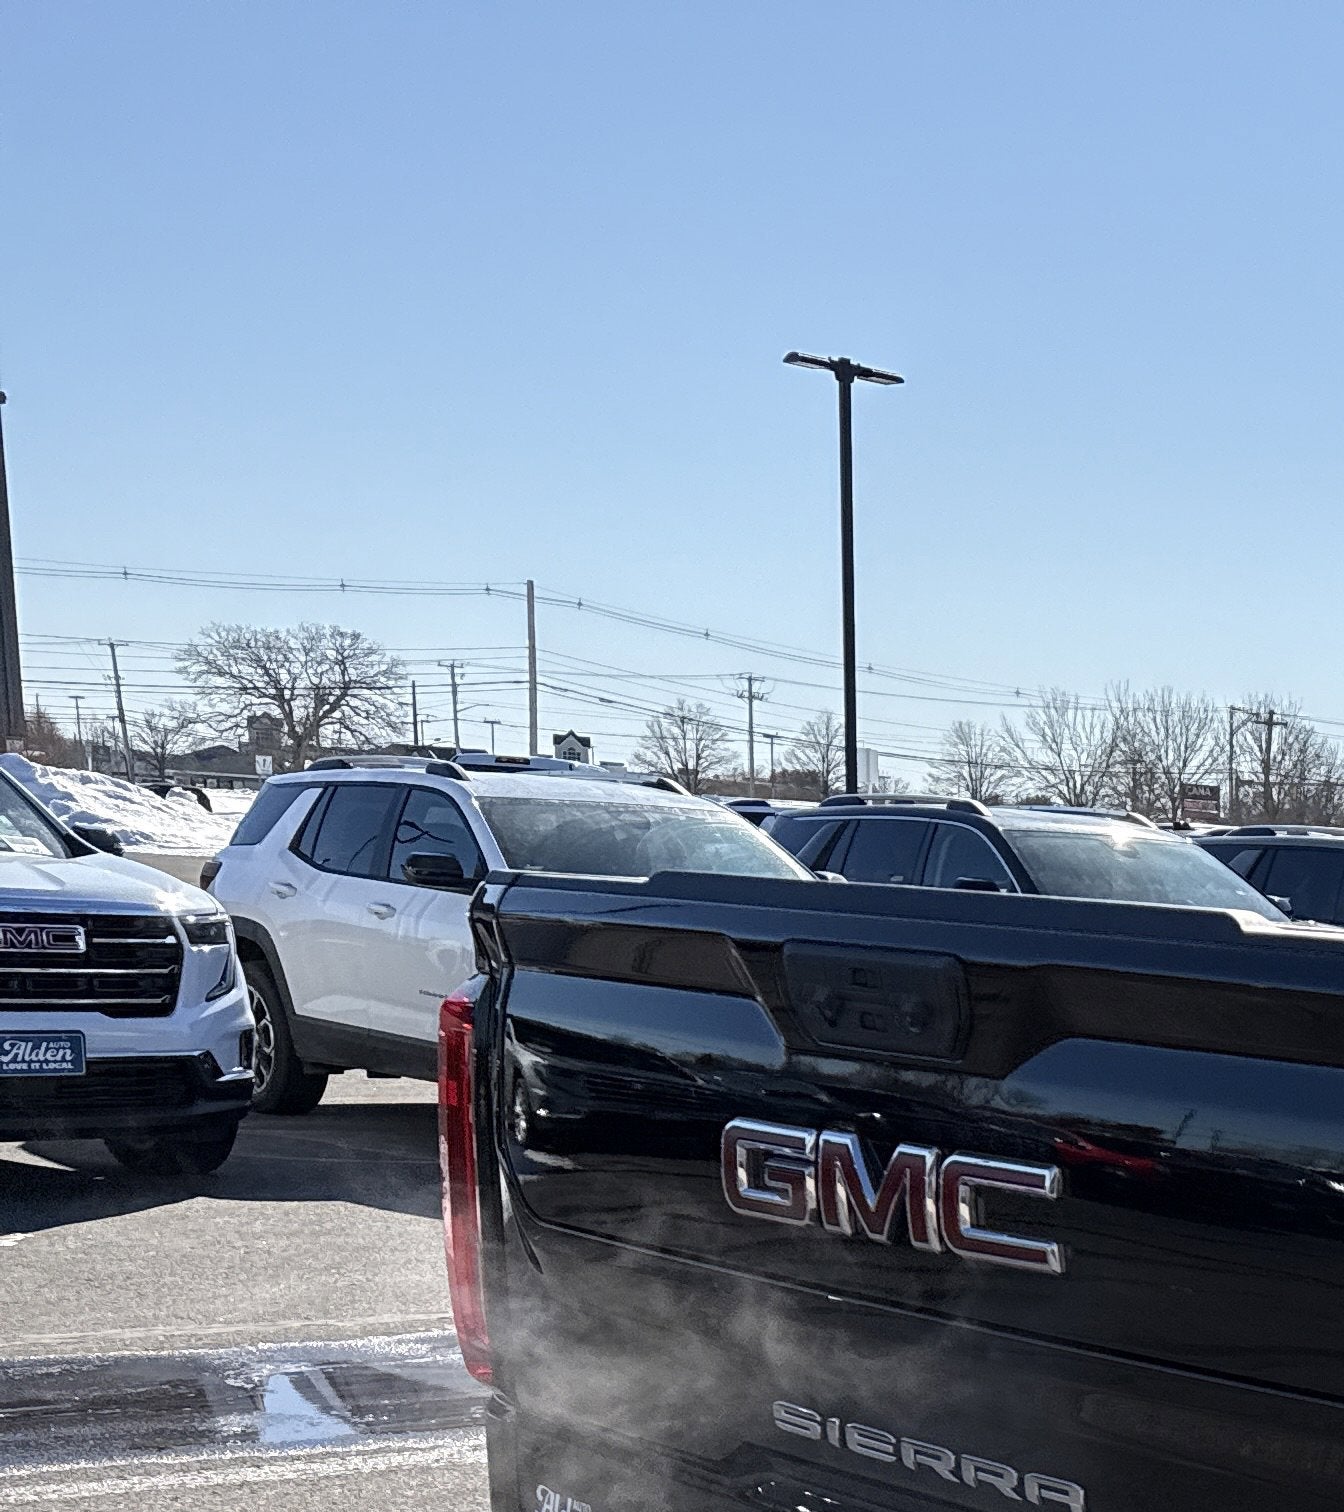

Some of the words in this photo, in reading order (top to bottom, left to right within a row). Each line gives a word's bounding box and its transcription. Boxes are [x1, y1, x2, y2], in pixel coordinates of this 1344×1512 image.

[0, 928, 81, 949] MC
[0, 1040, 75, 1062] Alden
[721, 1117, 1065, 1275] GMC
